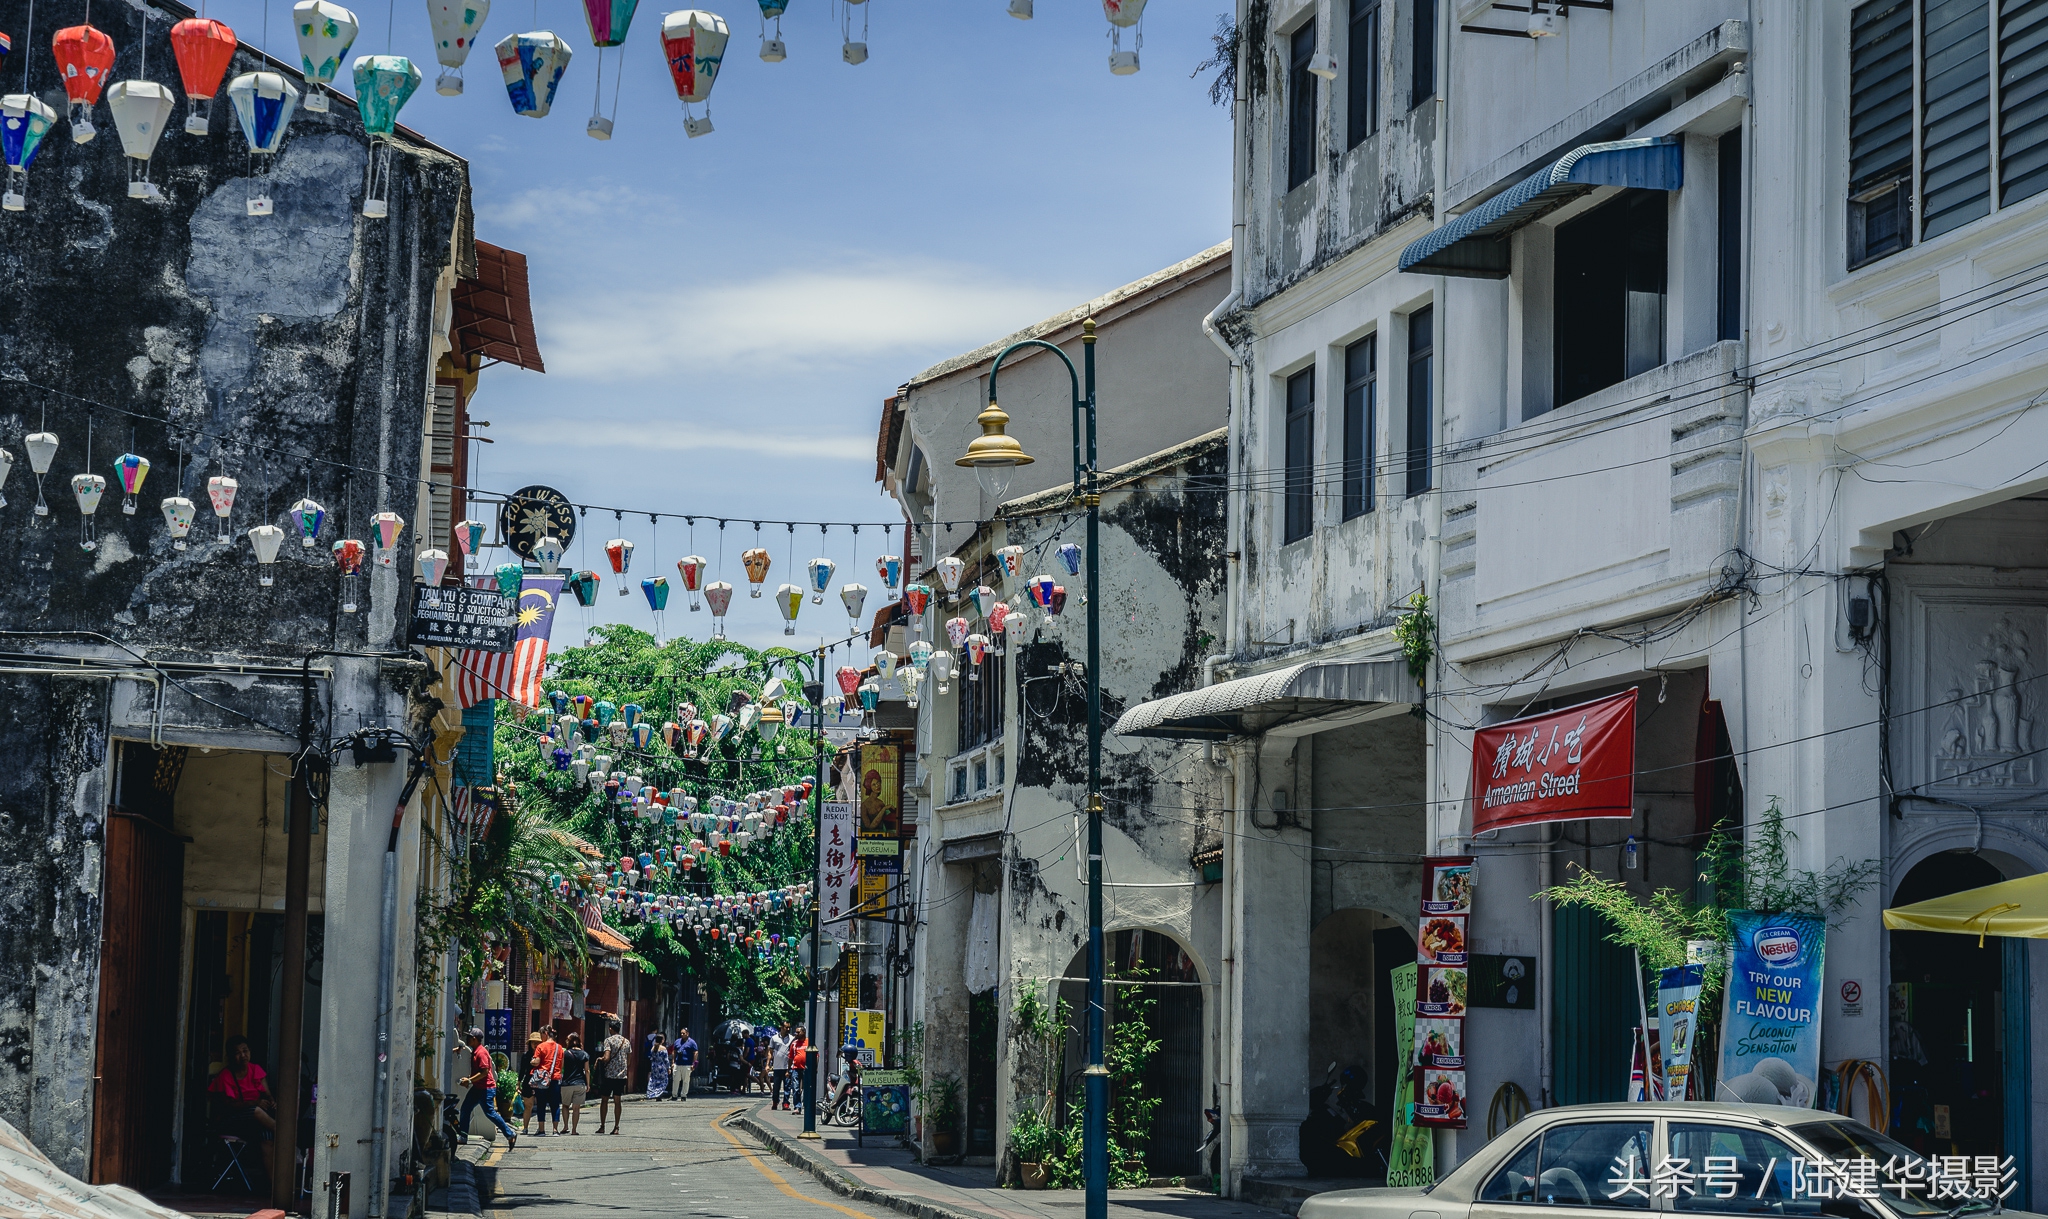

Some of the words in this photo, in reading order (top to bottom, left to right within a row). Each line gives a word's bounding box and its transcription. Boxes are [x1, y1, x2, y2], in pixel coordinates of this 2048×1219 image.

[505, 489, 572, 525] EDELWEISS
[420, 588, 439, 600] TAN
[443, 589, 456, 603] YU
[459, 592, 467, 604] &
[417, 610, 460, 622] PEGUAMBELA
[463, 613, 476, 624] DAN
[418, 600, 456, 612] ADVATES
[458, 604, 464, 613] &
[466, 605, 507, 617] SOLICITORS
[1482, 777, 1536, 810] Armenian
[1538, 768, 1581, 799] Street
[1769, 930, 1791, 938] CREAM
[1748, 971, 1771, 985] TRY
[1773, 975, 1802, 989] OUR
[1756, 986, 1793, 1005] NEW
[1666, 998, 1696, 1017] CHOOSE
[1736, 1000, 1811, 1023] FLAVOUR
[861, 1053, 872, 1062] 13
[1401, 1147, 1421, 1166] 013
[1389, 1166, 1433, 1188] 5261888
